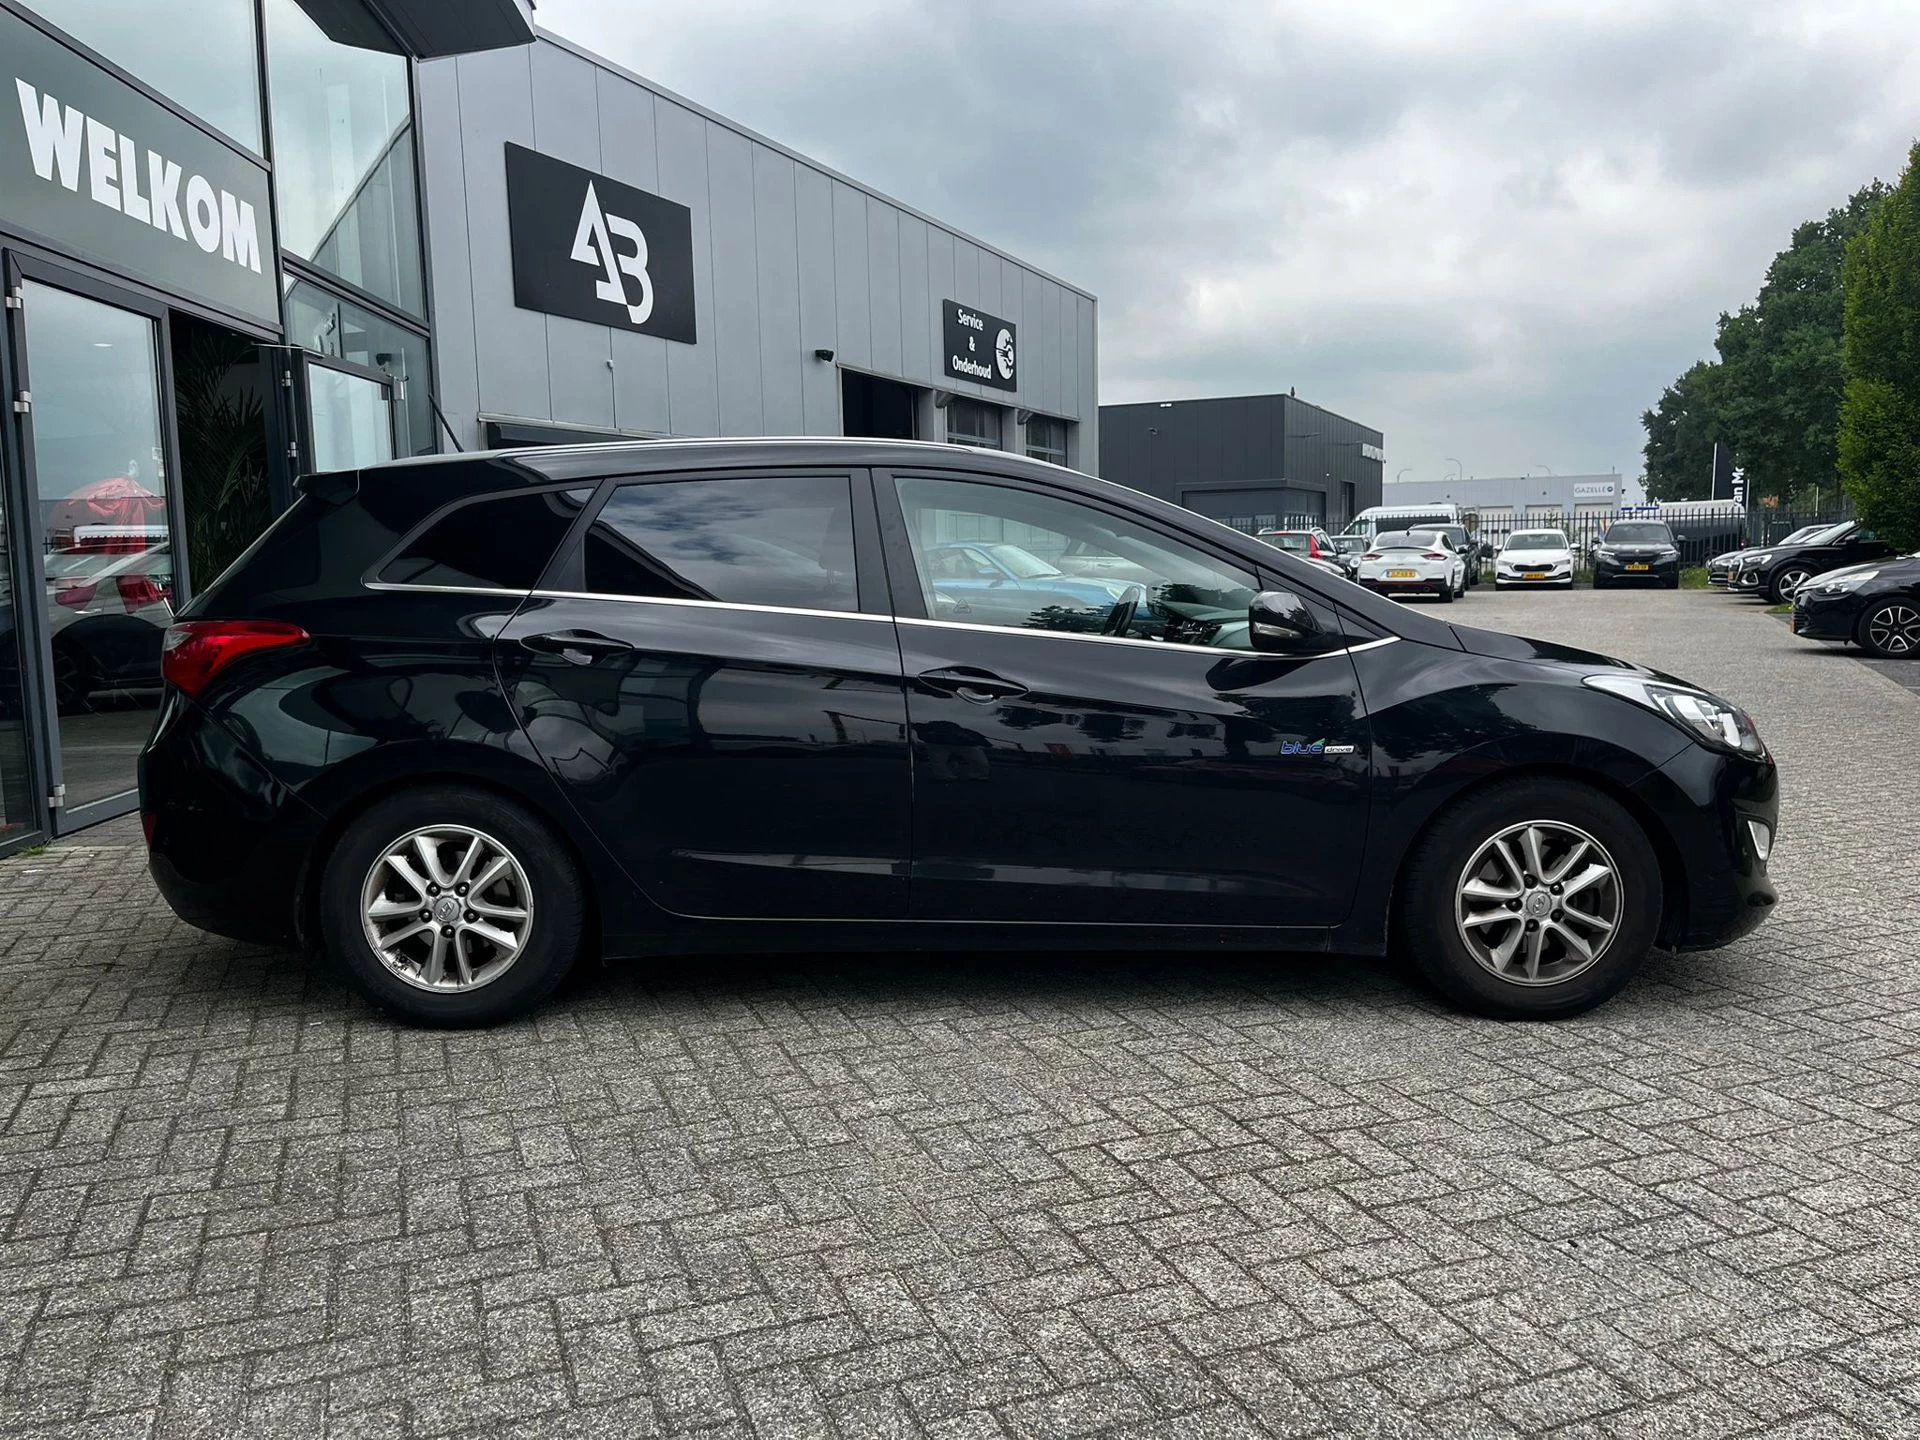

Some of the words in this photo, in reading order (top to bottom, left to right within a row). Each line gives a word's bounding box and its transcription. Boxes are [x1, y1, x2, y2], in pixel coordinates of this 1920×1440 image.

[15, 77, 262, 274] WELKOM
[570, 179, 654, 325] AB
[957, 308, 984, 332] Service
[968, 336, 976, 352] &
[952, 354, 992, 380] Onderhoud
[1574, 486, 1606, 494] GAZELLE
[1280, 740, 1323, 755] blue
